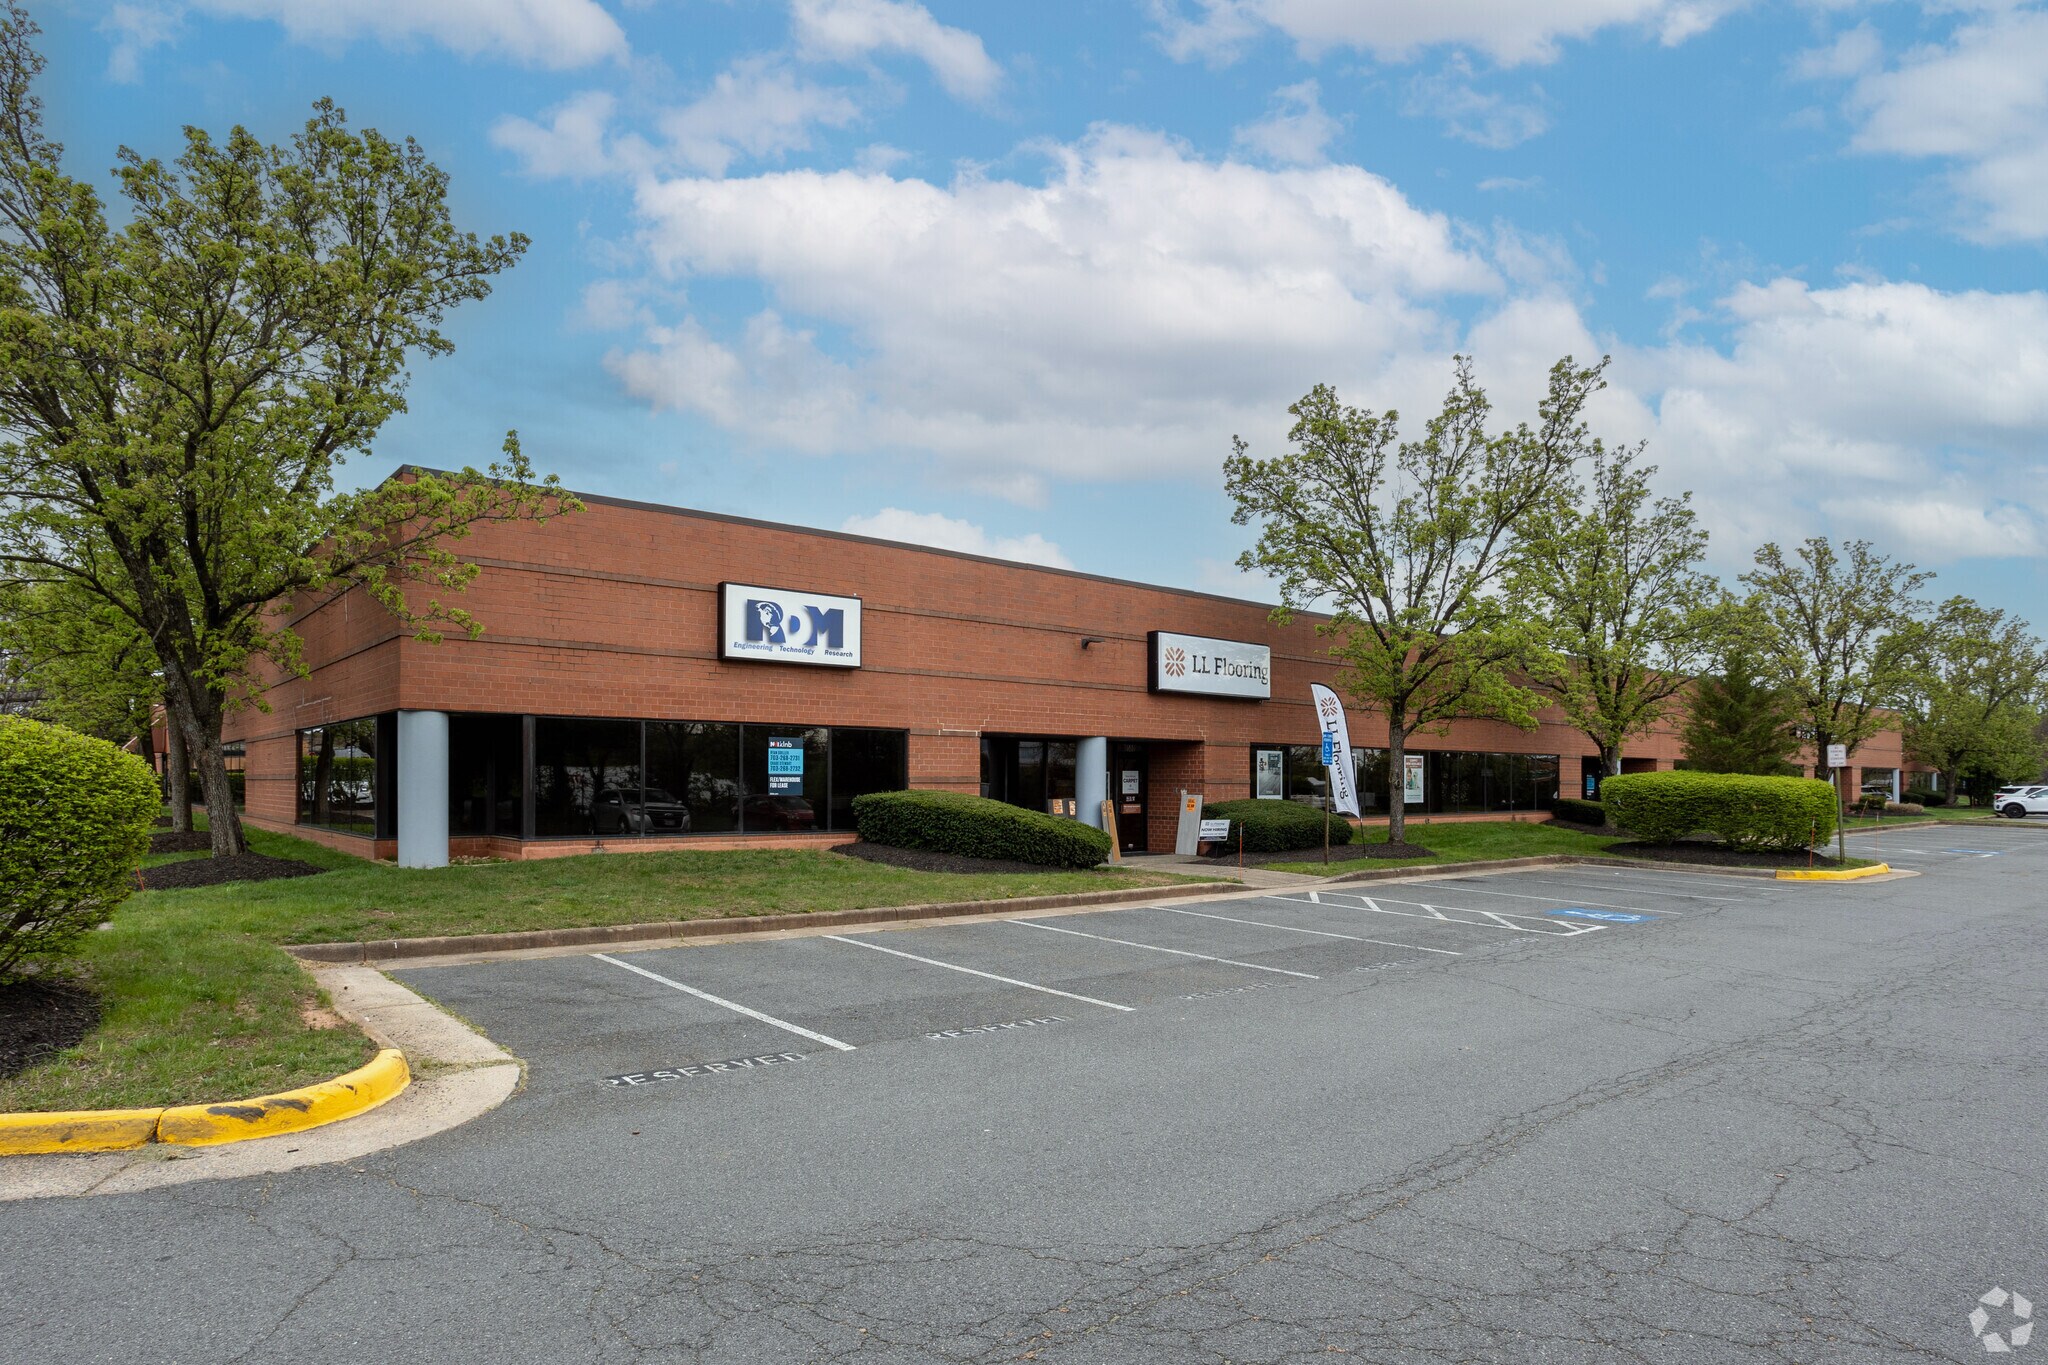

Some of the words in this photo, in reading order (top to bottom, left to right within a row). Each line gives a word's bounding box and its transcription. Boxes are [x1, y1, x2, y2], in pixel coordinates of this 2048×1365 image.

[733, 641, 773, 652] Engineering
[779, 645, 815, 656] Technology
[824, 649, 853, 658] Research
[1192, 655, 1211, 674] LL
[1214, 657, 1269, 685] Flooring
